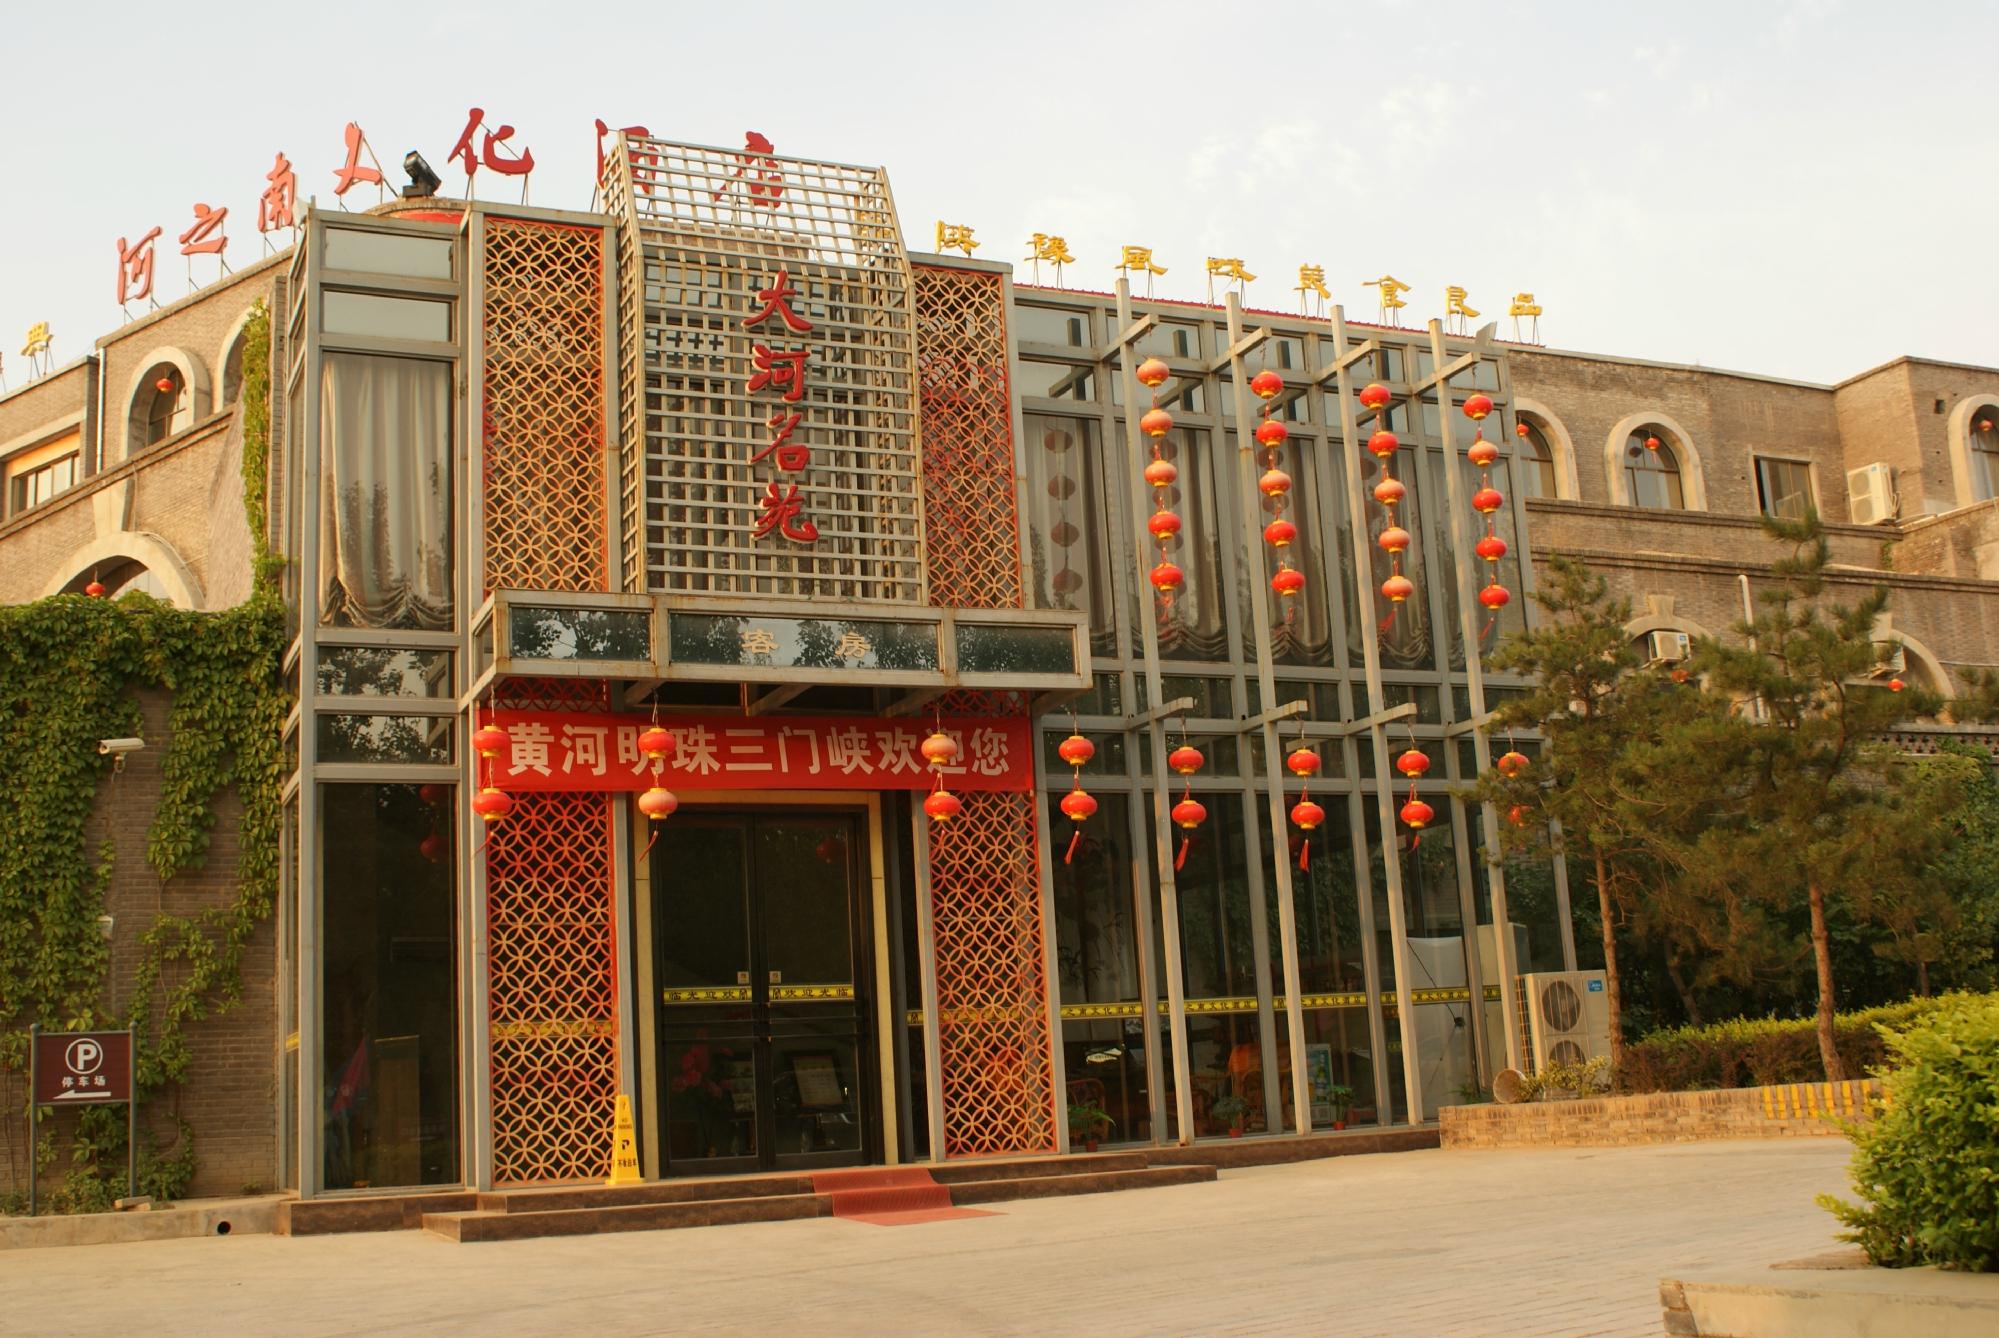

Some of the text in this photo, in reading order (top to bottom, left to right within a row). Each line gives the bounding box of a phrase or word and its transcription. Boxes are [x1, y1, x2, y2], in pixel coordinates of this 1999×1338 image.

[741, 628, 871, 658] 客房
[507, 722, 1010, 776] 黄河明珠三门峡欢迎您
[77, 1043, 97, 1070] P
[61, 1075, 106, 1088] 停车场
